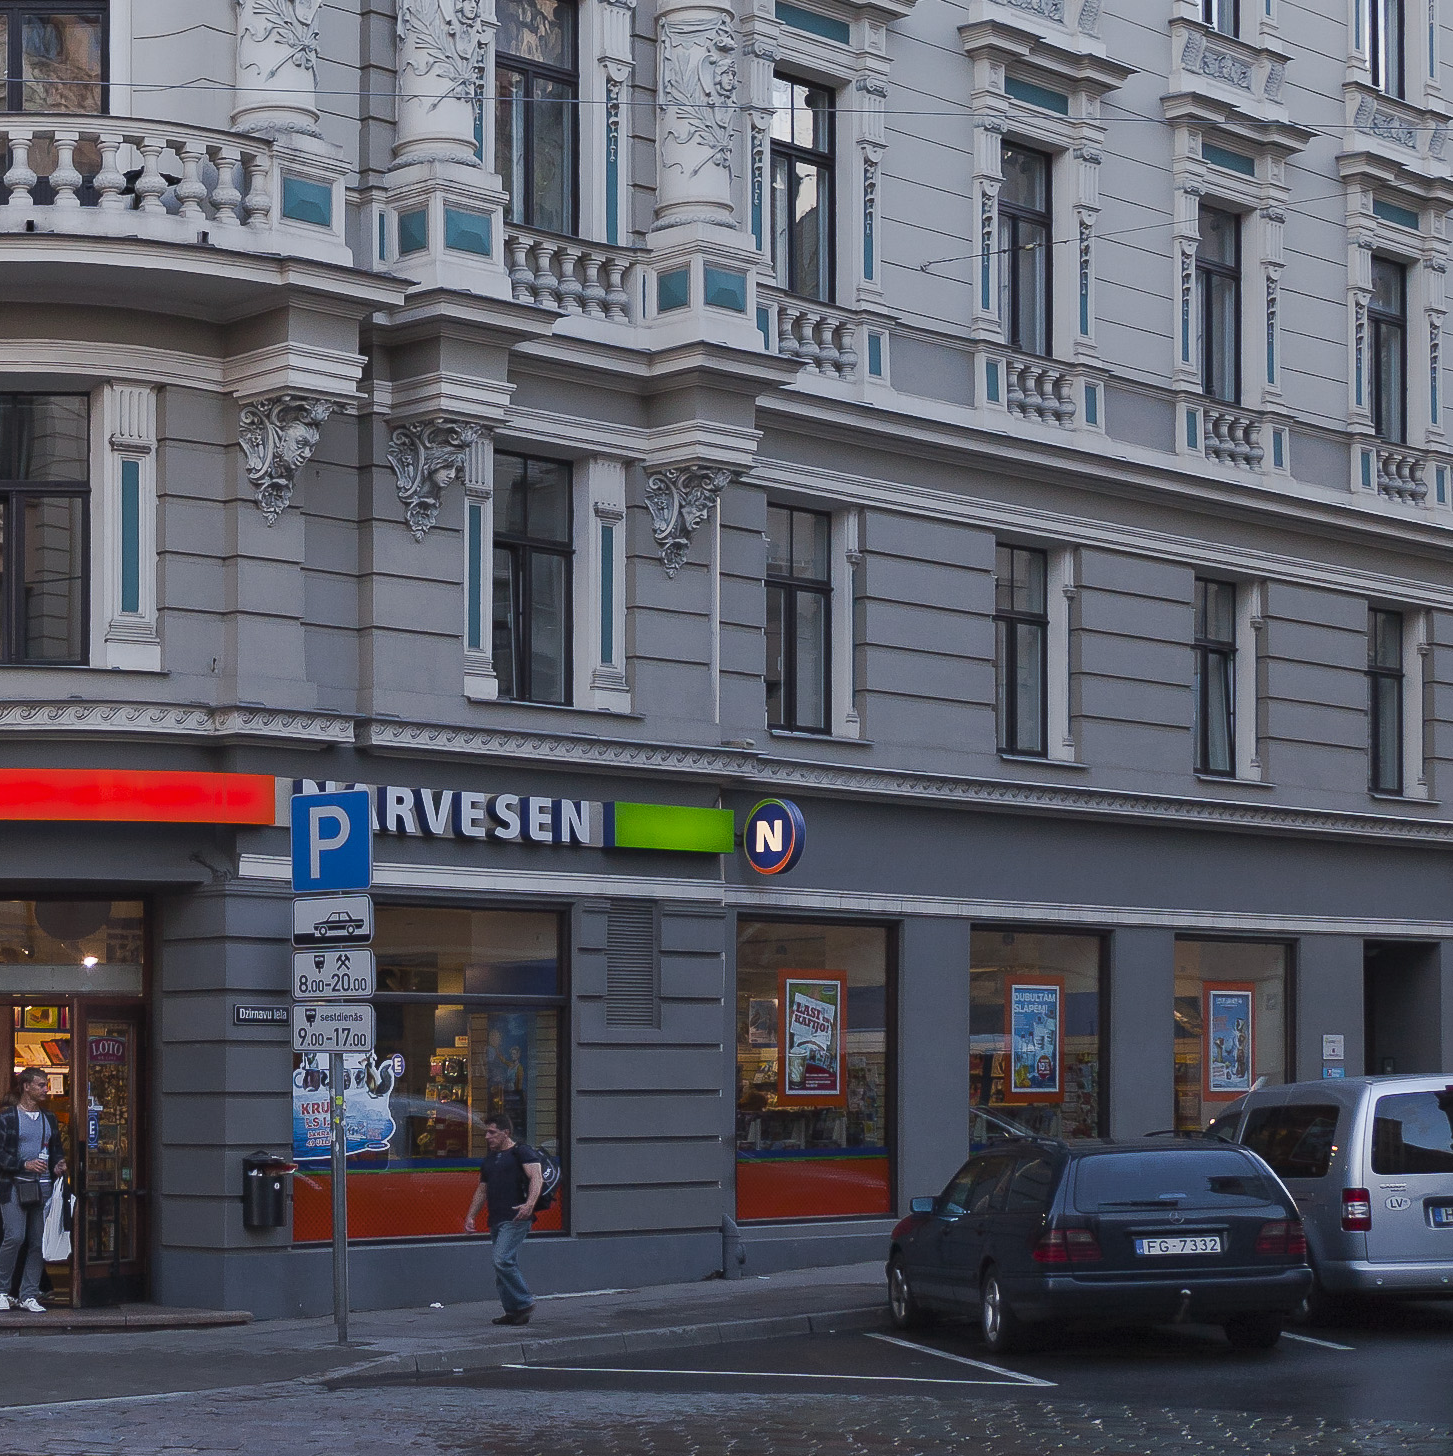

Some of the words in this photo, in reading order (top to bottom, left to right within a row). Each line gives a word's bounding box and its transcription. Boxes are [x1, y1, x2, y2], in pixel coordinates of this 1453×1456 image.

[309, 805, 351, 879] P
[755, 819, 783, 853] N
[298, 973, 367, 993] 8.00-20.00
[239, 1008, 272, 1019] Dzirnavu
[320, 1013, 364, 1022] sestdienās
[298, 1027, 367, 1047] 9.00-17.00
[92, 1041, 123, 1056] LOTO
[1389, 1198, 1403, 1208] LV
[1146, 1237, 1219, 1253] FG-7332
